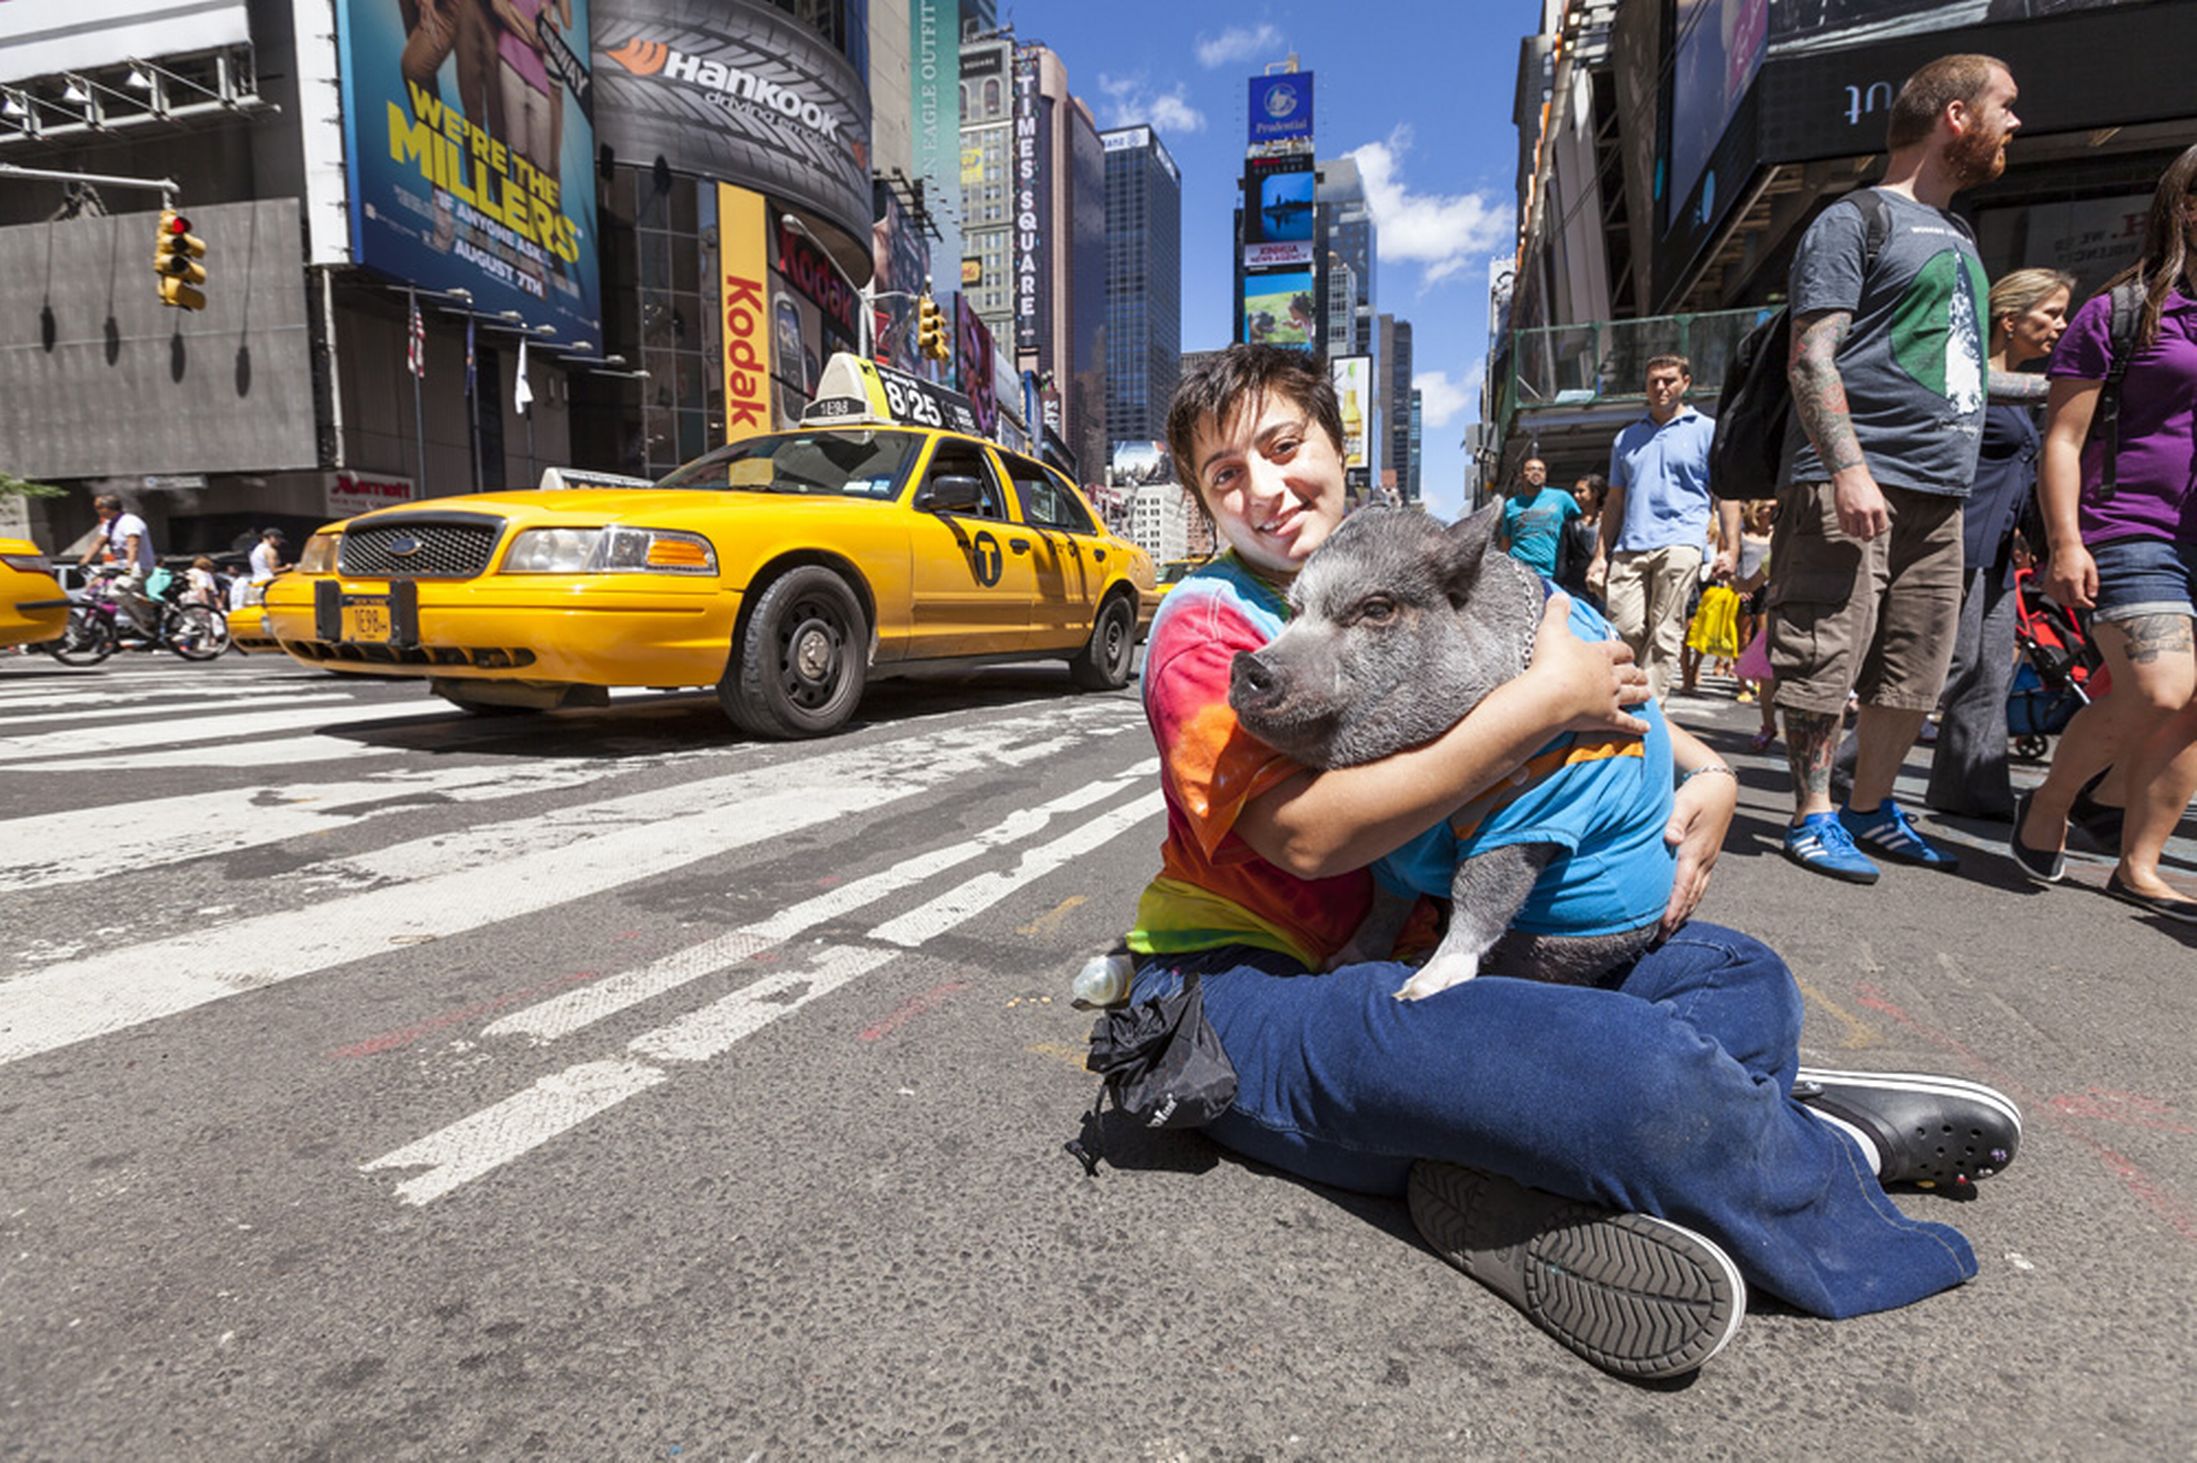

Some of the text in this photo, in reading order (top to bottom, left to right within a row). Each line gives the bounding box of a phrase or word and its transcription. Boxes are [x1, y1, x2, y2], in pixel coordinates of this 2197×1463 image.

[408, 79, 508, 175] WE'RE
[511, 151, 560, 208] THE
[922, 84, 937, 150] EAGLE
[1016, 76, 1036, 179] TIMES
[1256, 120, 1308, 133] Prudential
[387, 99, 580, 264] MILLERS
[454, 239, 515, 282] AUGUST
[1018, 191, 1037, 316] SQUARE
[726, 274, 767, 429] Kodak
[884, 380, 943, 428] 8/25
